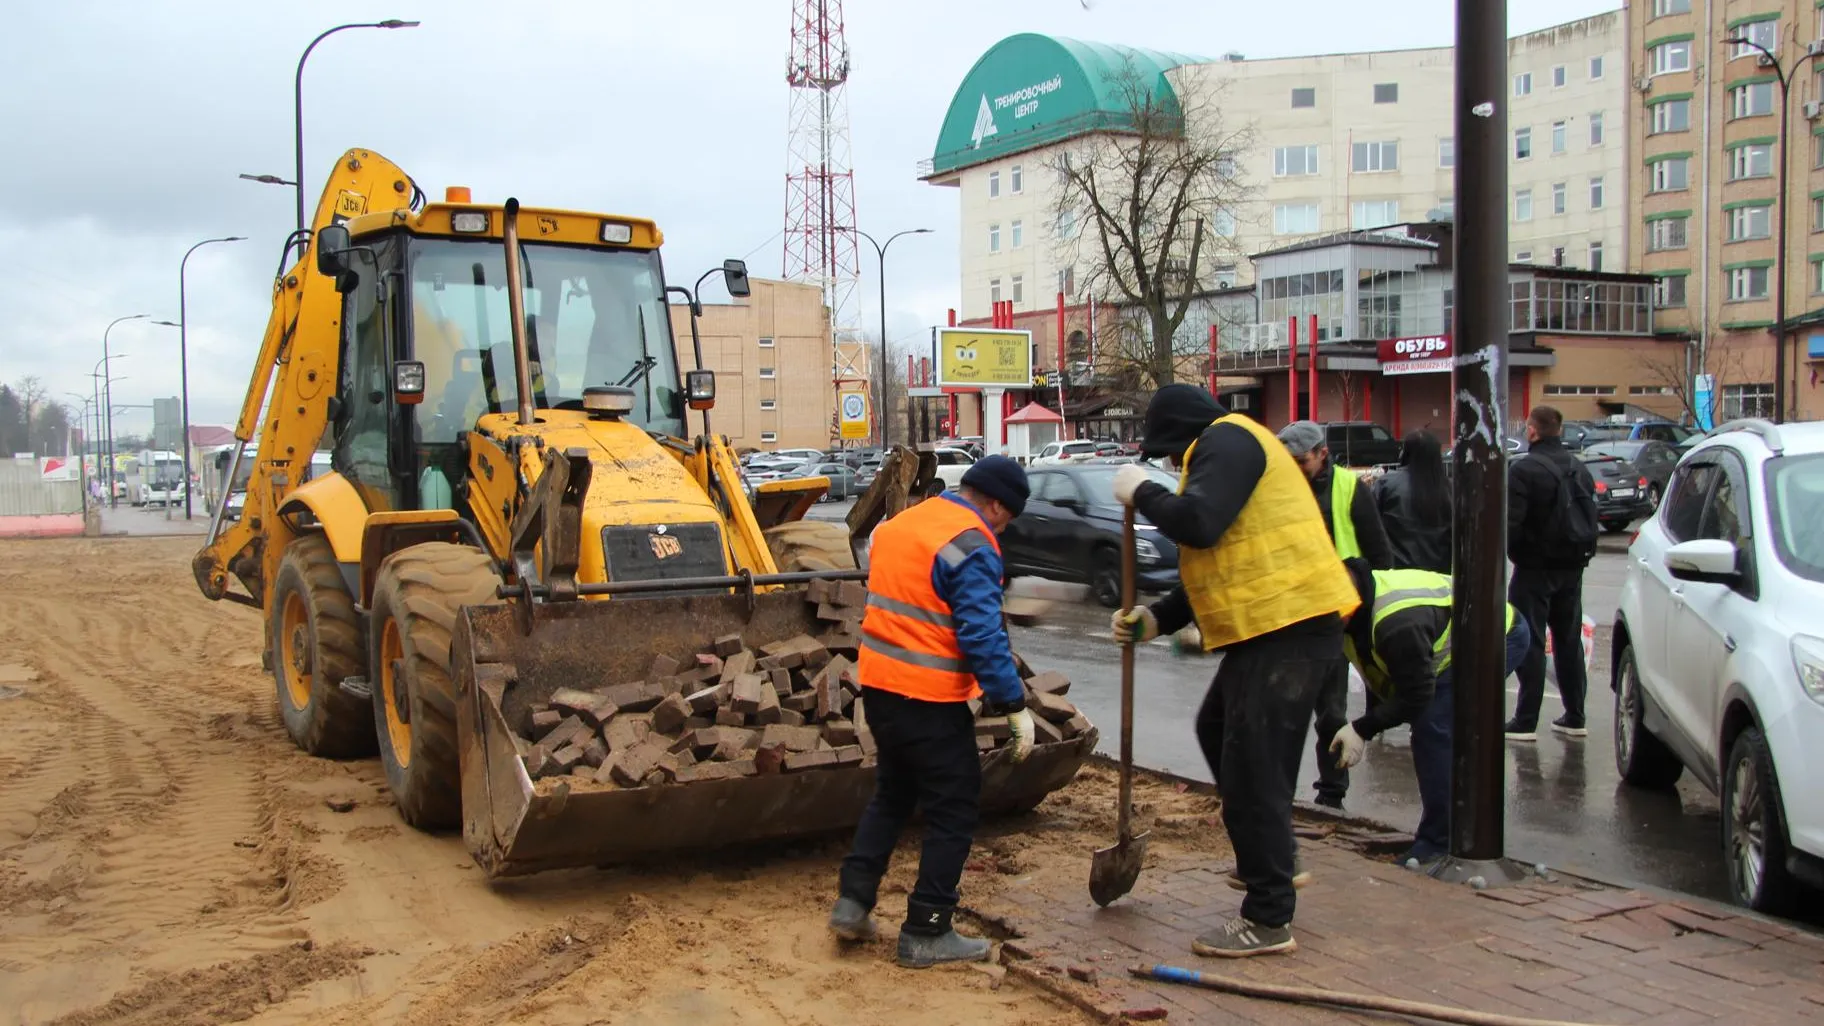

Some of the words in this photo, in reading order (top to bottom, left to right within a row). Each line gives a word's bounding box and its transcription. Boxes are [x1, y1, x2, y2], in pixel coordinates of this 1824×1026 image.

[994, 74, 1062, 111] ТРЕНИРОВОЧНЫЙ
[1014, 100, 1039, 119] ЦЕНТР
[343, 198, 361, 212] JCB
[1395, 337, 1447, 354] ОБУВЬ
[1384, 363, 1409, 372] АРЕНДА
[650, 536, 680, 559] JCB
